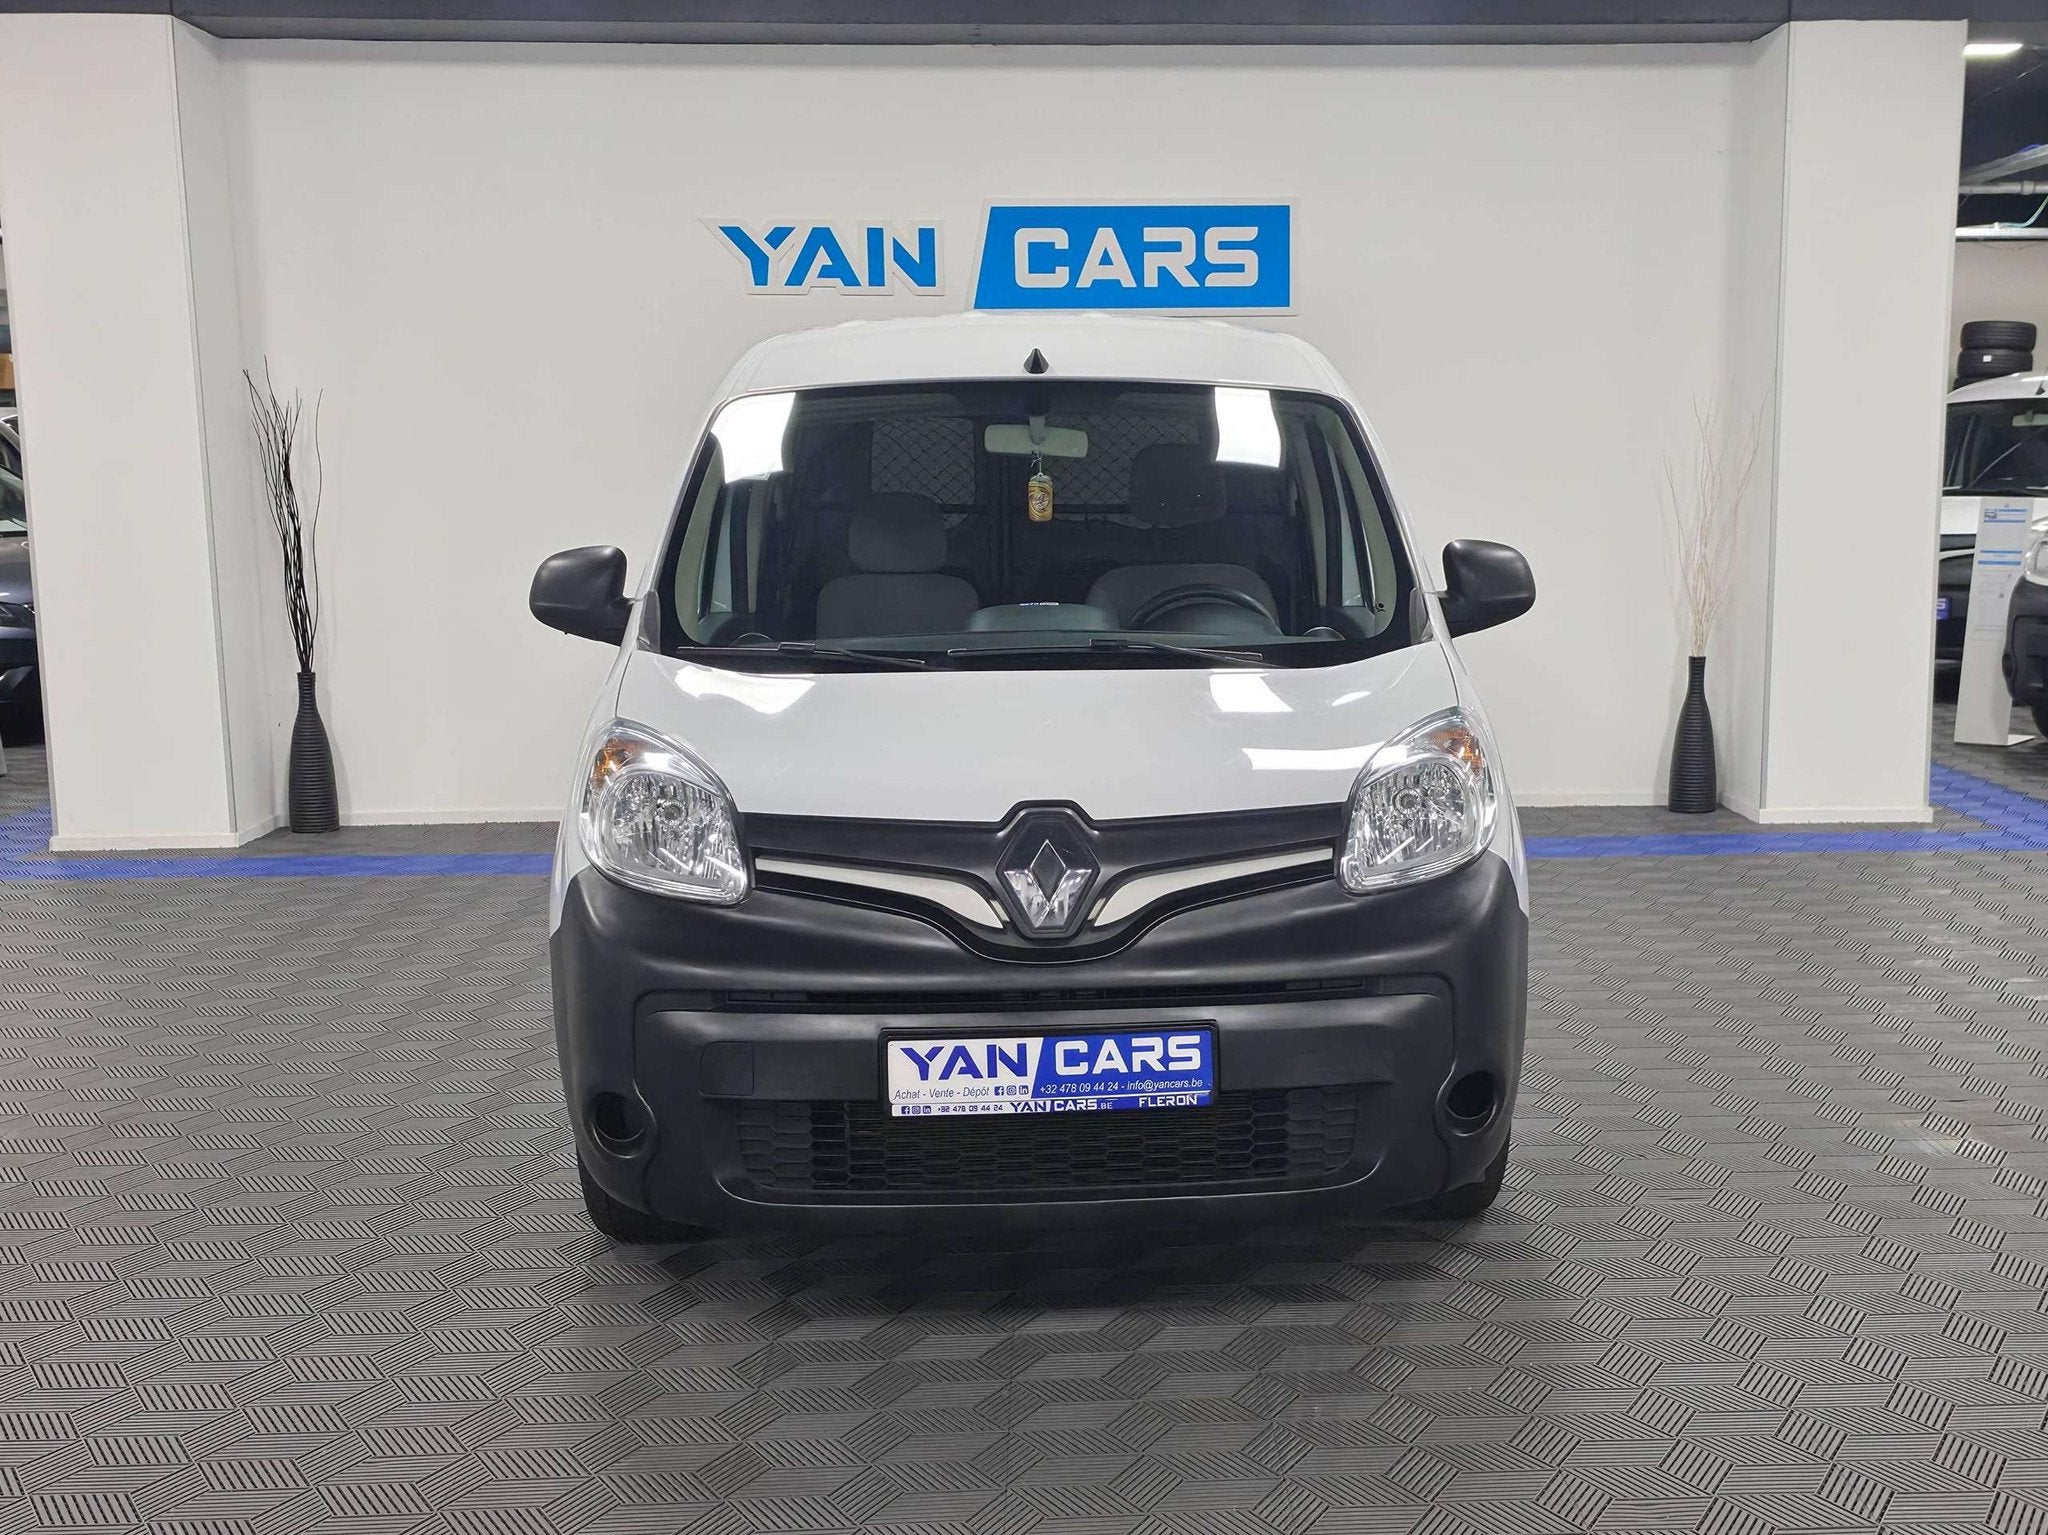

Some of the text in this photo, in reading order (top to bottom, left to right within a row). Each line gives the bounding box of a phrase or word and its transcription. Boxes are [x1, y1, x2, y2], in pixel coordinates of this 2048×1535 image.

[718, 225, 1260, 288] YAN CARS
[900, 1035, 1201, 1081] YAN CARS
[893, 1089, 920, 1100] Achat
[929, 1088, 954, 1098] Vente
[963, 1086, 990, 1097] Dépôt
[1040, 1084, 1057, 1094] +32
[1060, 1083, 1076, 1093] 478
[1079, 1082, 1091, 1092] 09
[1093, 1082, 1105, 1091] 44
[1107, 1081, 1119, 1091] 24
[1127, 1078, 1203, 1092] info@yancars.be
[1010, 1101, 1047, 1113] YAN
[1139, 1094, 1198, 1108] FLERON
